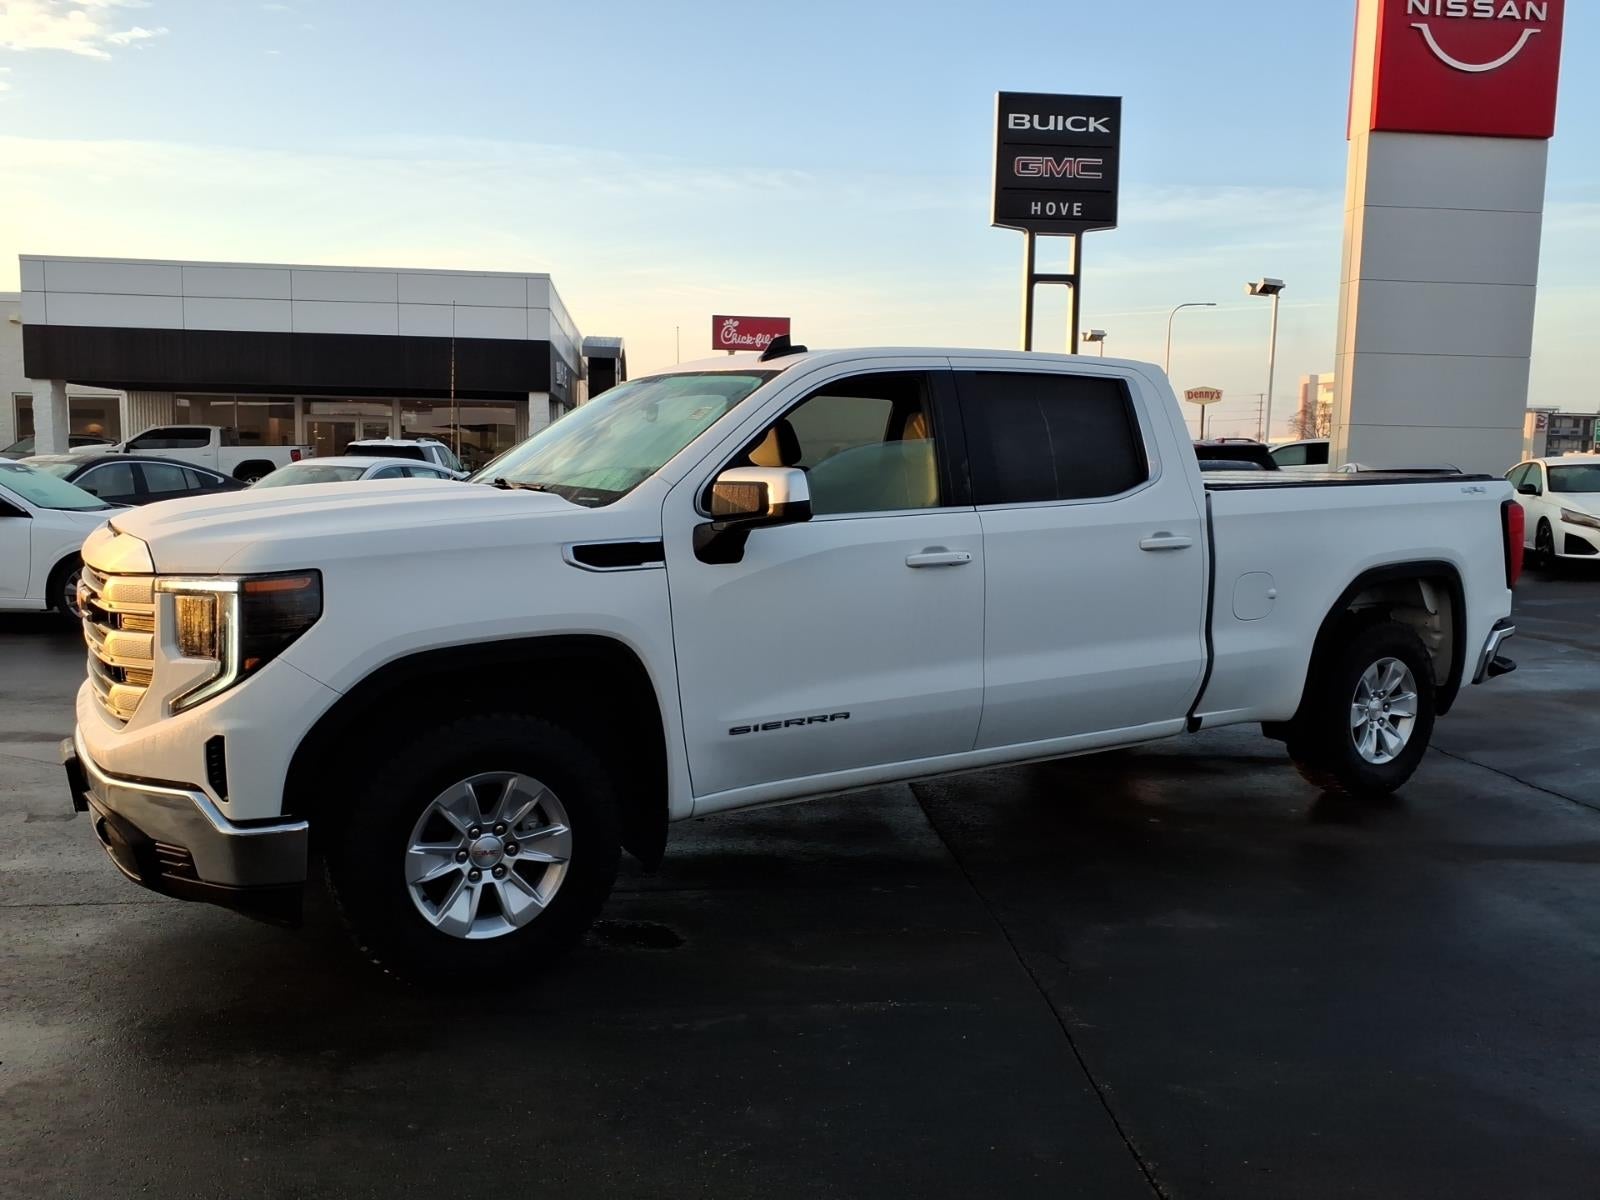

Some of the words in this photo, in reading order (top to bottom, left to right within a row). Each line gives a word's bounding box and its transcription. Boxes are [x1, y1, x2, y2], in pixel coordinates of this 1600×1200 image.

[1407, 0, 1548, 21] NISSAN
[1008, 113, 1111, 133] BUICK
[1014, 156, 1103, 179] GMC
[1031, 201, 1082, 216] HOVE
[720, 321, 781, 348] Chick-fil-
[1187, 389, 1221, 401] Denny's
[728, 711, 850, 735] SIERRA
